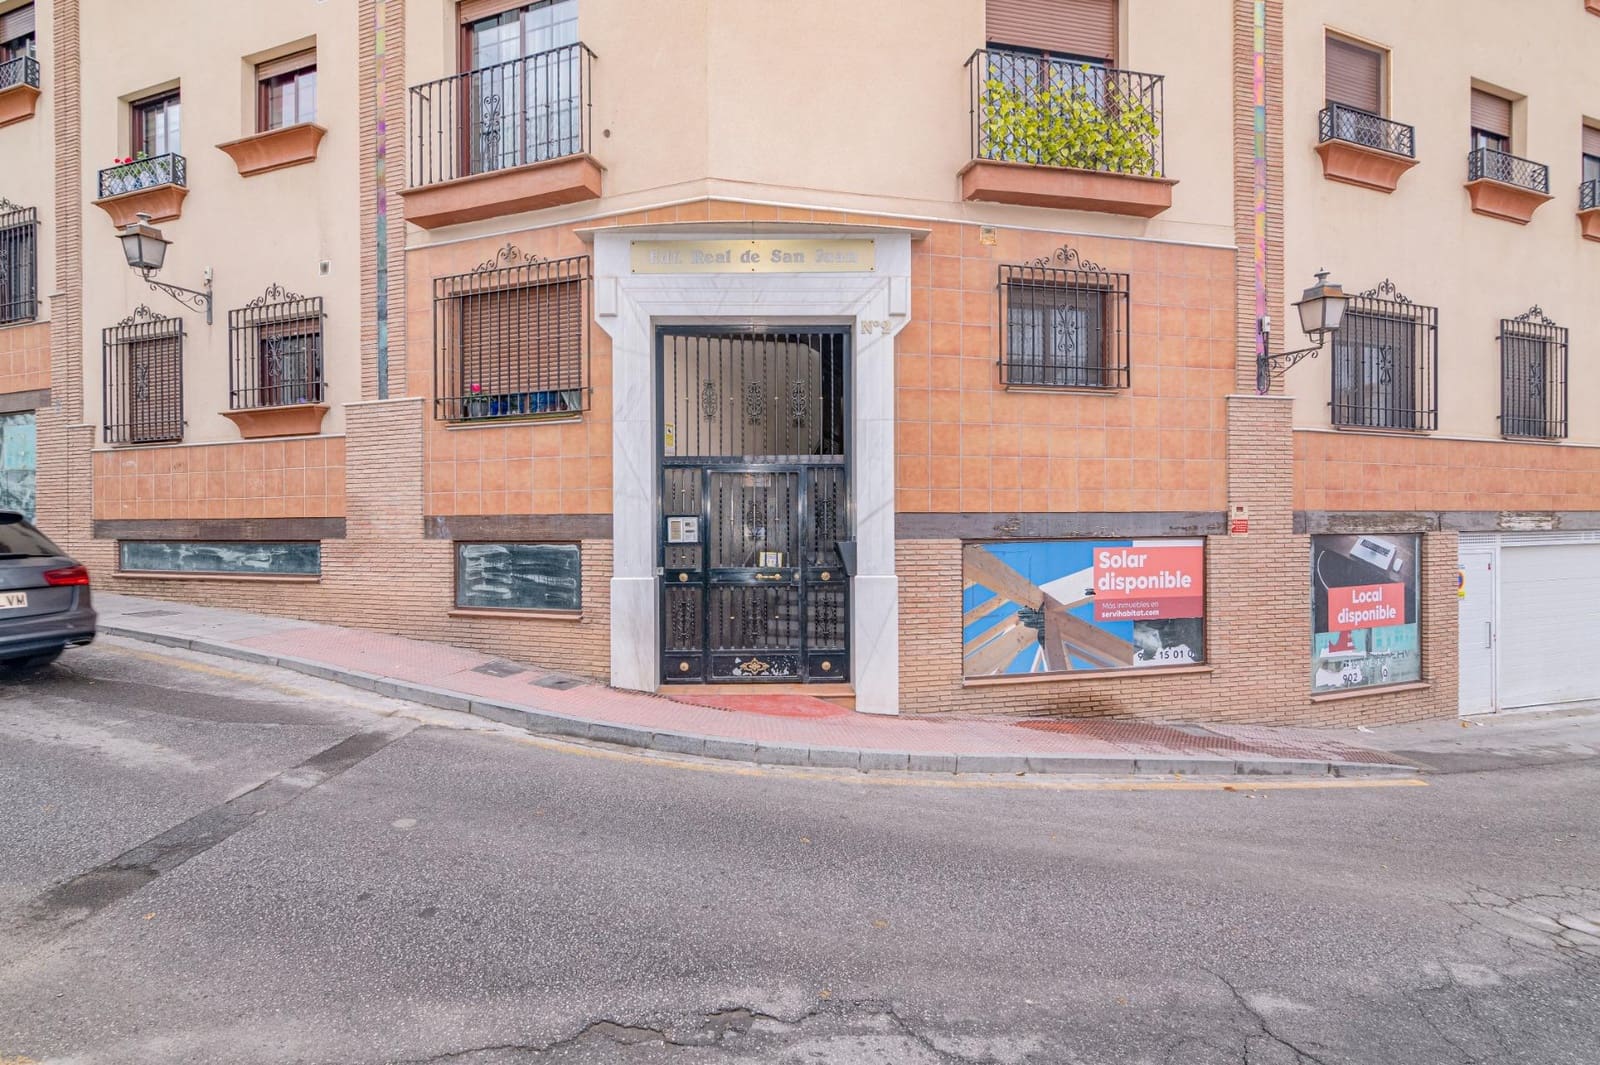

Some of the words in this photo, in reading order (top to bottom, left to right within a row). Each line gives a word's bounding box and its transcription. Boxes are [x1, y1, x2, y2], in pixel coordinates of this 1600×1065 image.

[690, 249, 731, 263] Real
[740, 249, 761, 263] de
[770, 249, 805, 263] San
[1099, 550, 1147, 569] Solar
[1098, 571, 1192, 594] disponible
[1352, 587, 1382, 603] Local
[1101, 609, 1160, 618] servihabitat.com
[1337, 605, 1397, 625] disponible
[1160, 651, 1170, 660] 15
[1173, 650, 1184, 659] 01
[1342, 672, 1358, 684] 902
